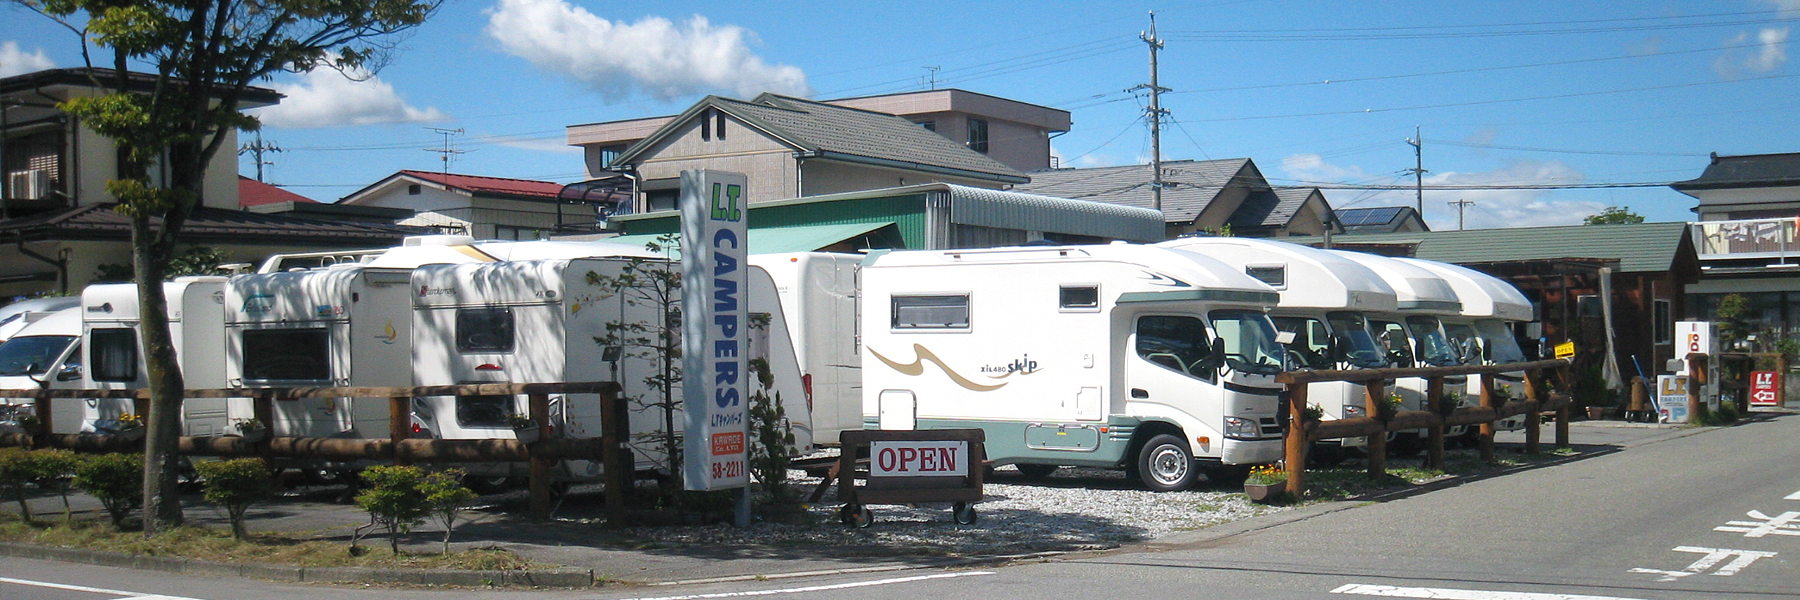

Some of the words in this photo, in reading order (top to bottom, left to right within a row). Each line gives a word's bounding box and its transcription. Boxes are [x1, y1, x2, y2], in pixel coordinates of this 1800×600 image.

[713, 228, 740, 408] CAMPERS
[1556, 346, 1573, 354] OPEN
[1007, 353, 1038, 373] skip
[878, 447, 958, 472] OPEN
[712, 461, 744, 479] 58-2211
